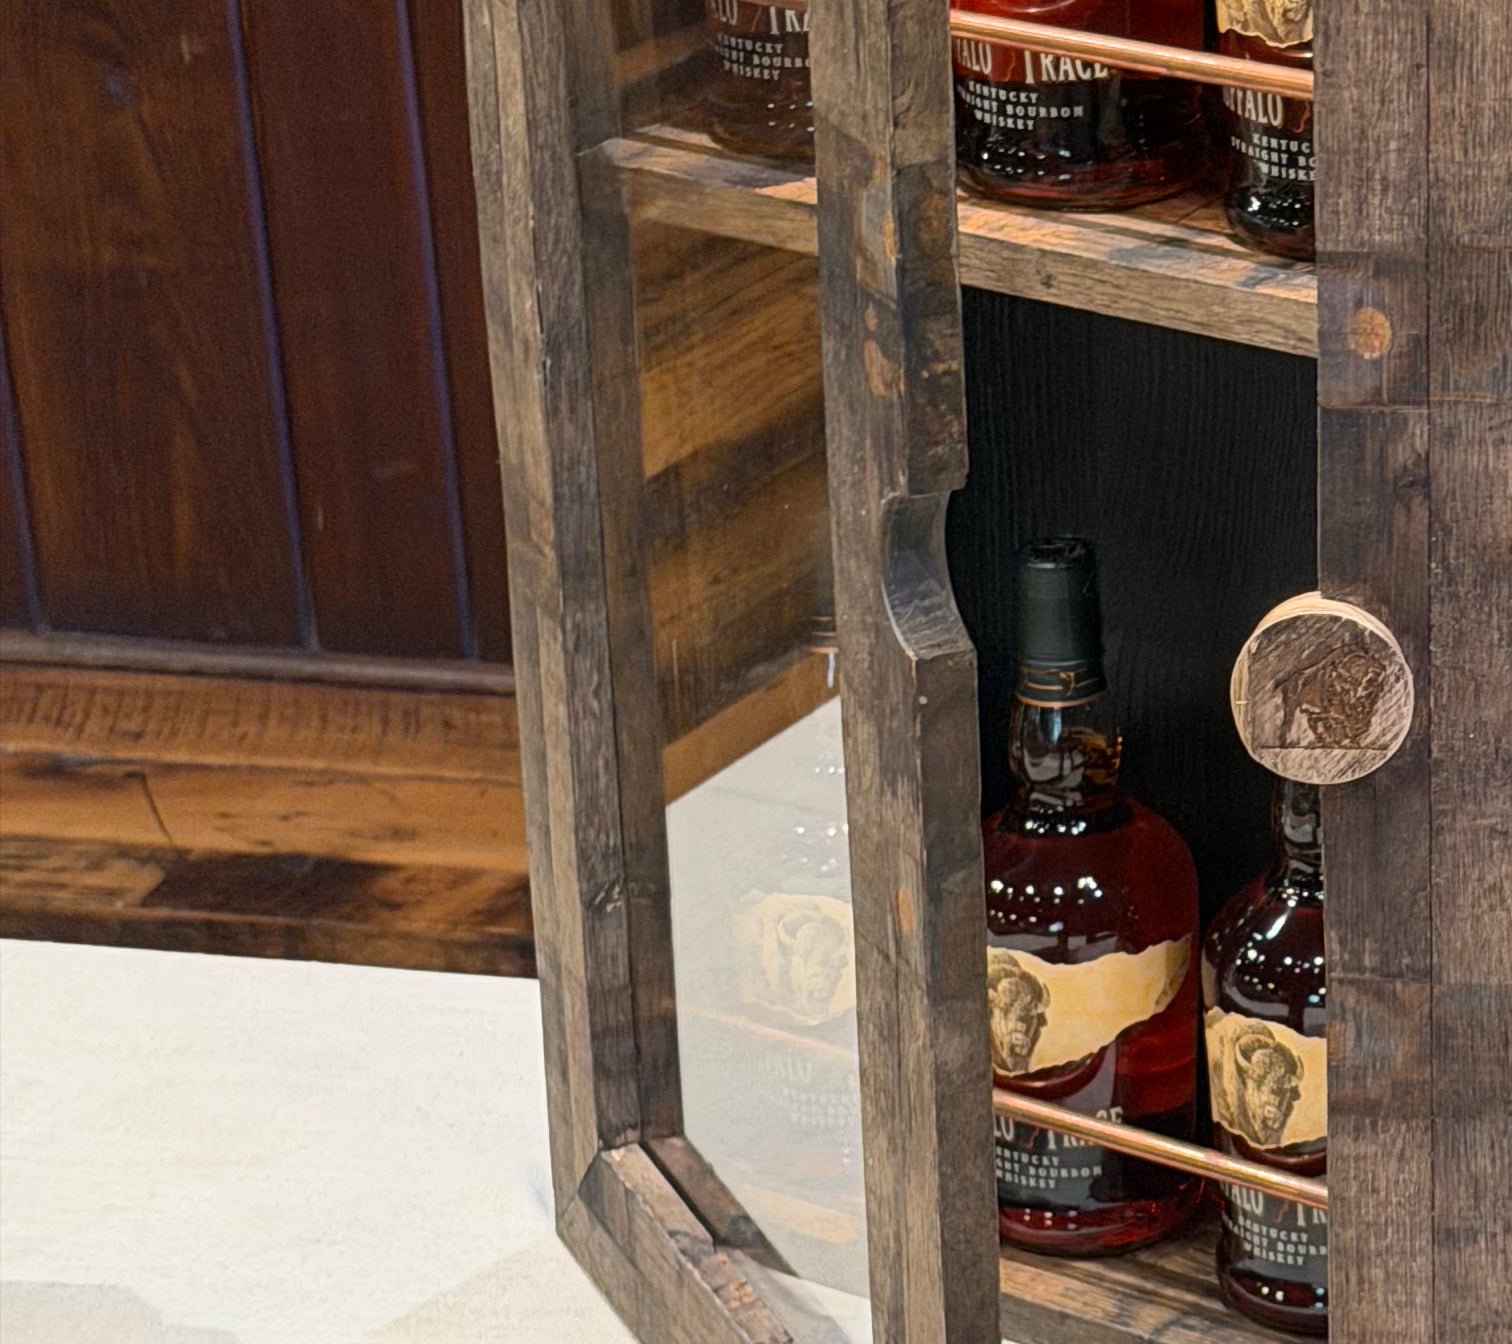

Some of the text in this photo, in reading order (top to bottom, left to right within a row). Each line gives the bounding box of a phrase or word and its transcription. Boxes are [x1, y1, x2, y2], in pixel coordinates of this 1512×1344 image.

[753, 54, 811, 68] BOURBO
[968, 80, 1039, 103] KENTUCKY
[974, 109, 1035, 130] WHISKEY
[1006, 104, 1084, 118] BOURBON
[1252, 133, 1311, 154] KENTUC
[1257, 161, 1317, 181] WHISKE
[996, 1146, 1059, 1166] ENTUCKY
[1029, 1165, 1102, 1178] BOURBON
[1277, 1241, 1328, 1256] BOURB
